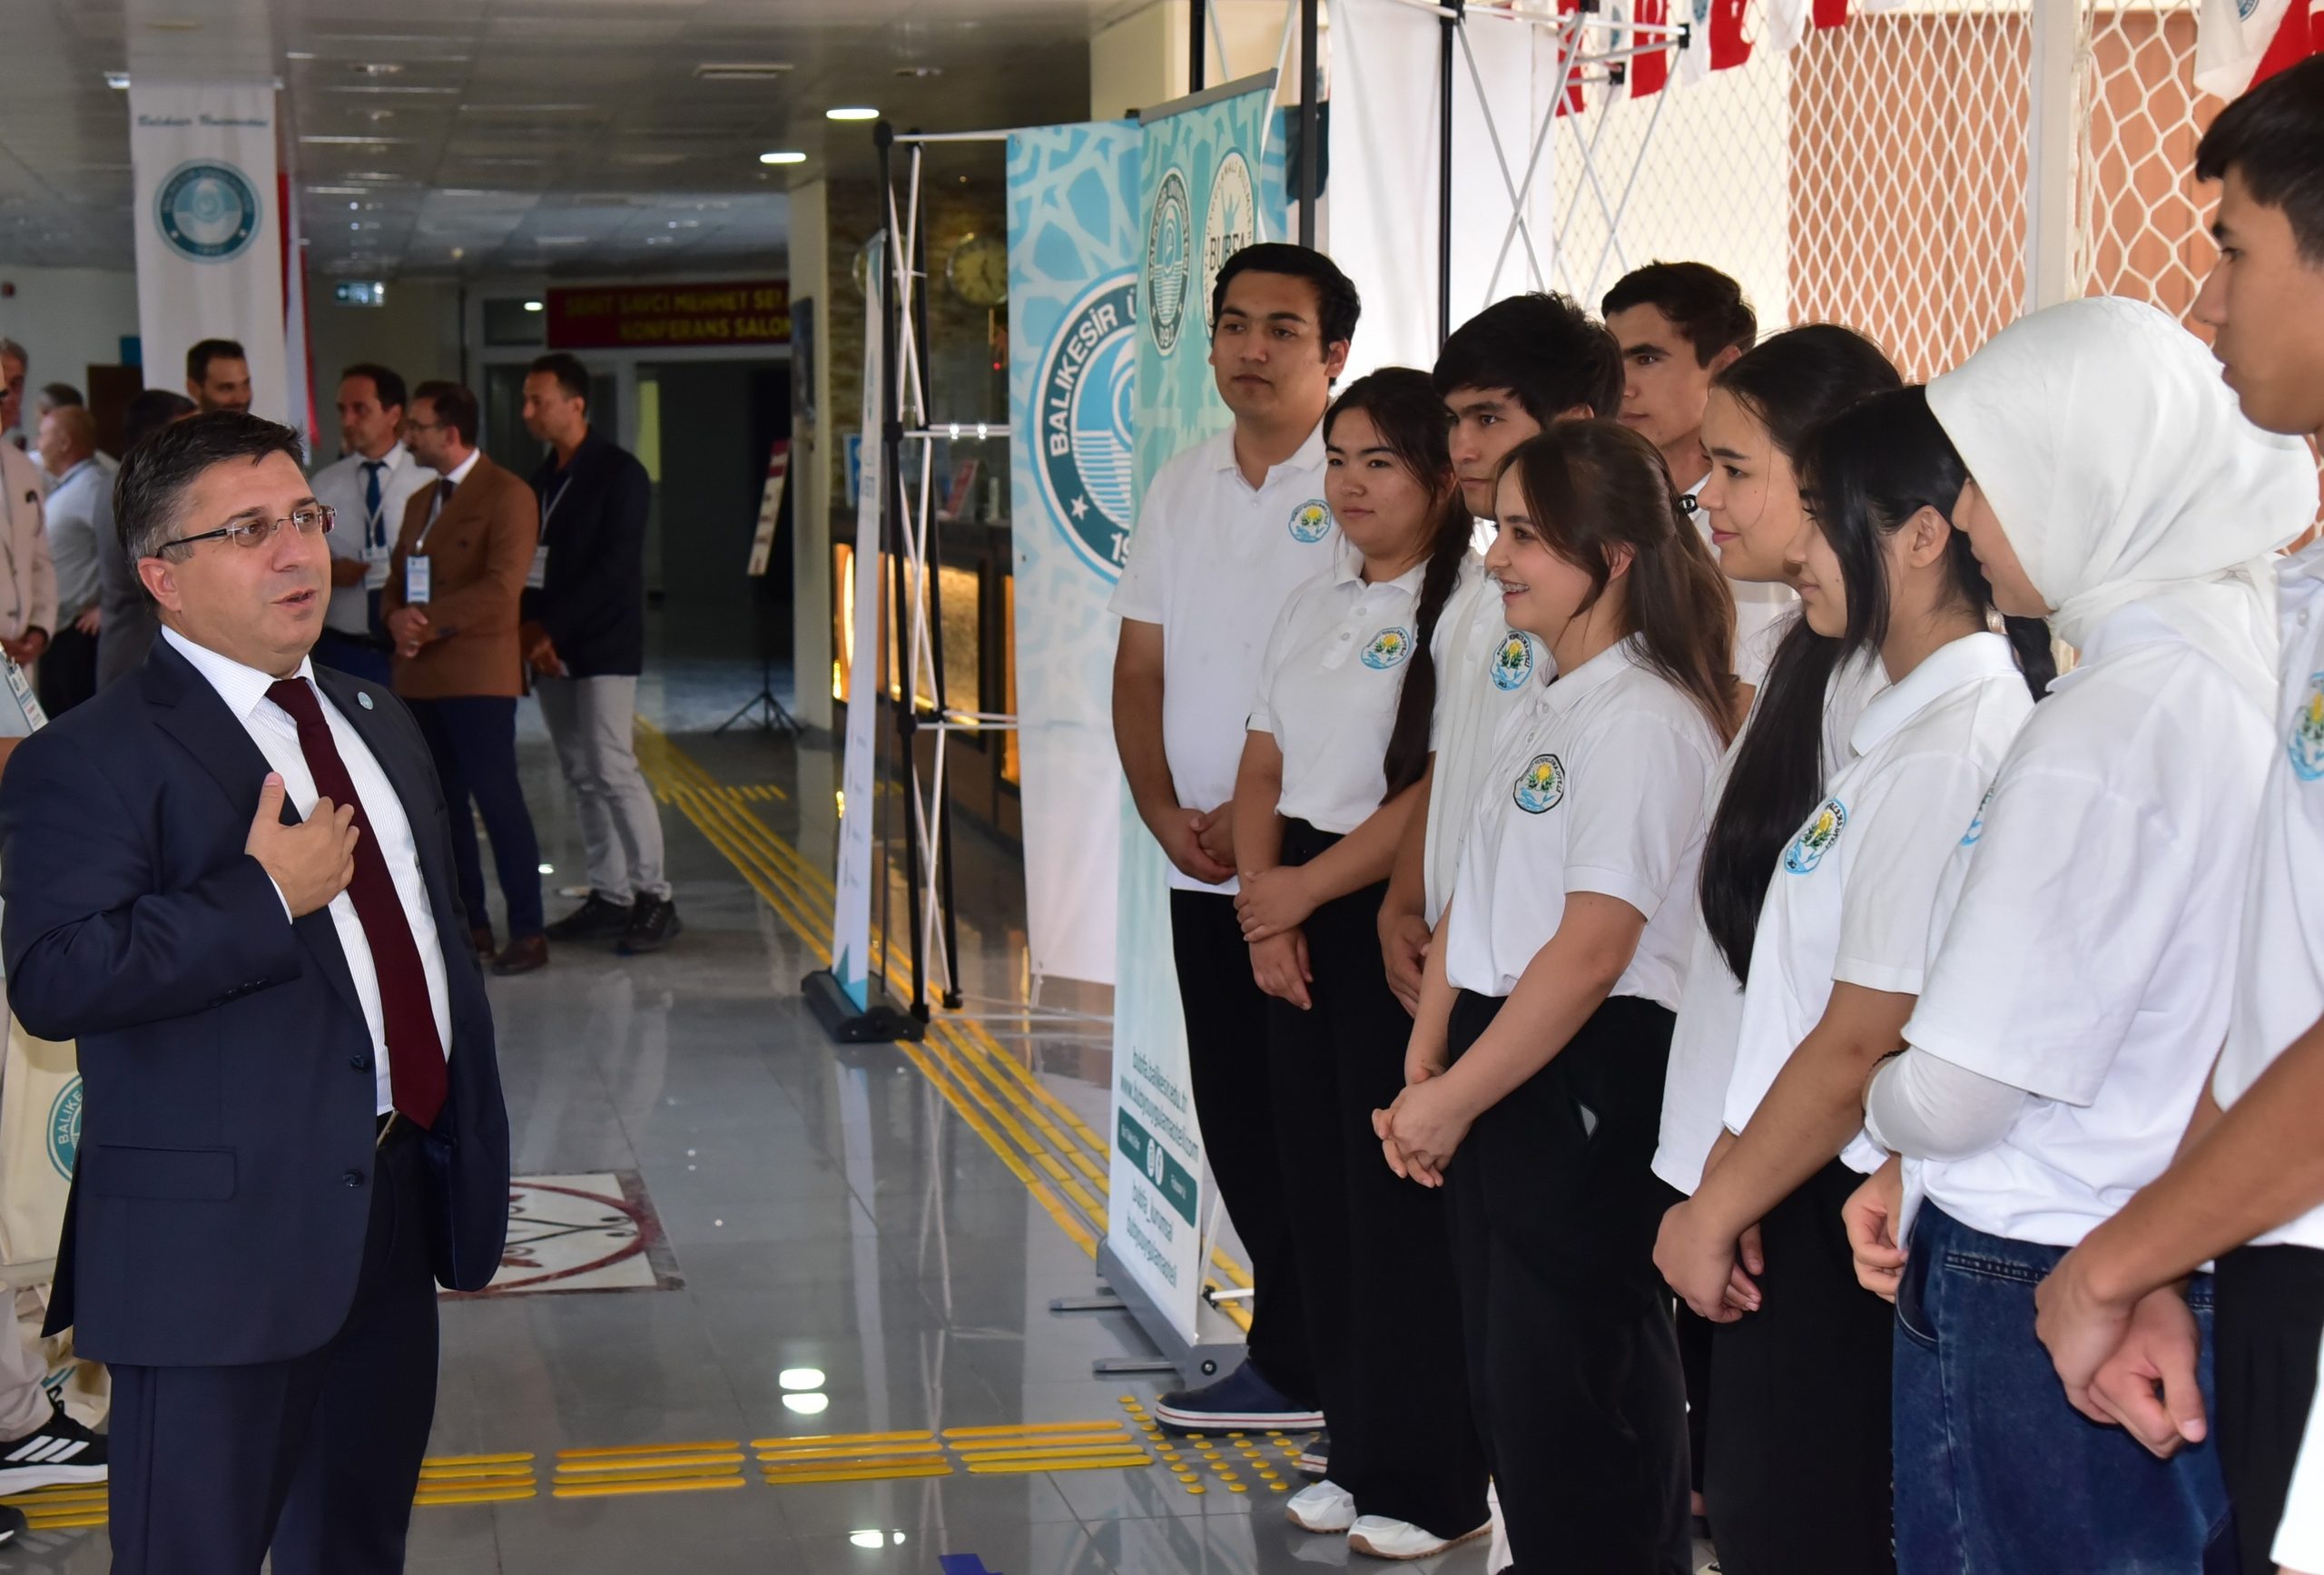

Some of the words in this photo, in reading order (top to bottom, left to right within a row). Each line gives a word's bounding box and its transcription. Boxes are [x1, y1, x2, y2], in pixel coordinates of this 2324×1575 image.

[620, 318, 730, 340] KONFERANS
[1049, 302, 1118, 458] BALIKESİR
[57, 1089, 83, 1146] BALIKE
